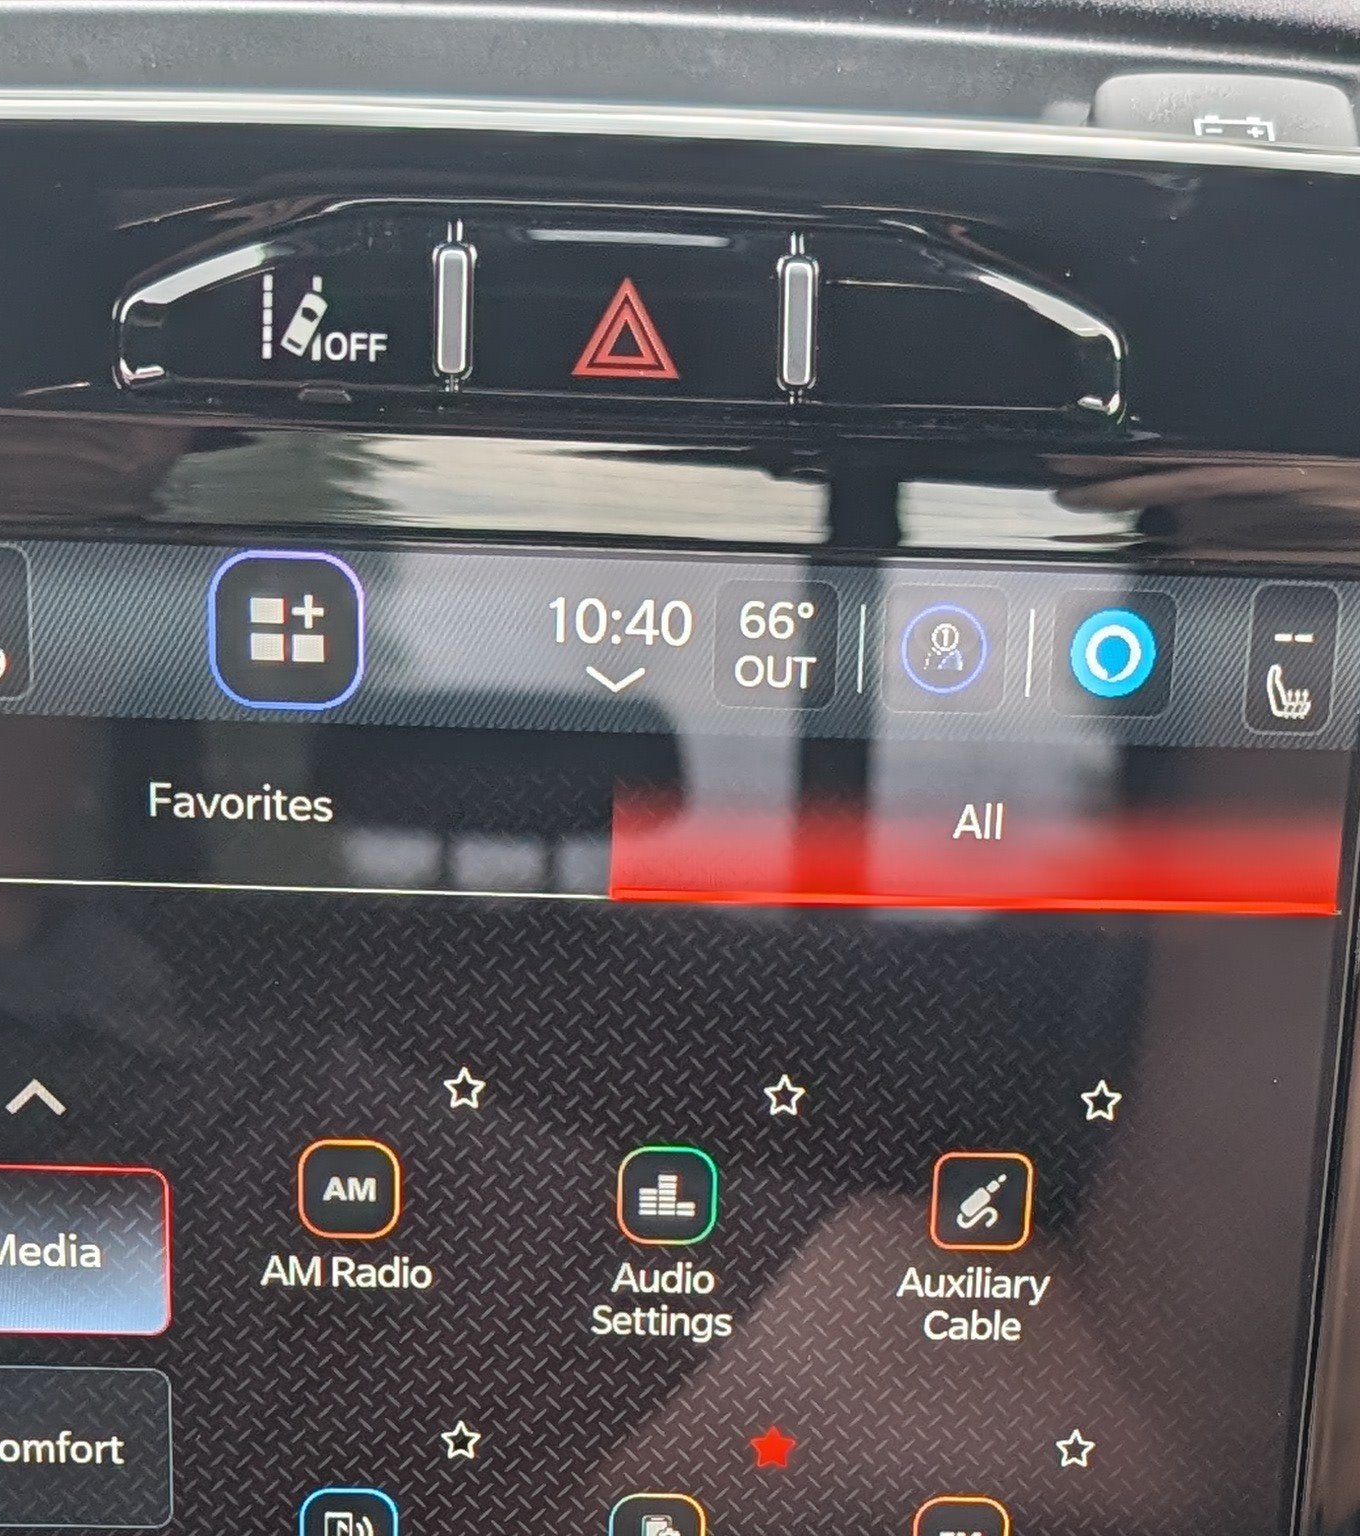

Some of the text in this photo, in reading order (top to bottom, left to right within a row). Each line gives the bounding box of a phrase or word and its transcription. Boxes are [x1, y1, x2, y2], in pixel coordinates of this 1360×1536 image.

[324, 331, 388, 363] OFF
[548, 596, 693, 647] 10:40
[739, 600, 814, 640] 66°
[734, 654, 817, 689] OUT
[149, 781, 333, 822] Favorites
[952, 802, 1004, 840] All
[322, 1176, 377, 1202] AM
[260, 1254, 433, 1289] AM Radio
[610, 1261, 715, 1294] Audio
[896, 1266, 1051, 1306] Auxiliary
[590, 1304, 733, 1344] Settings
[923, 1308, 1022, 1341] Cable
